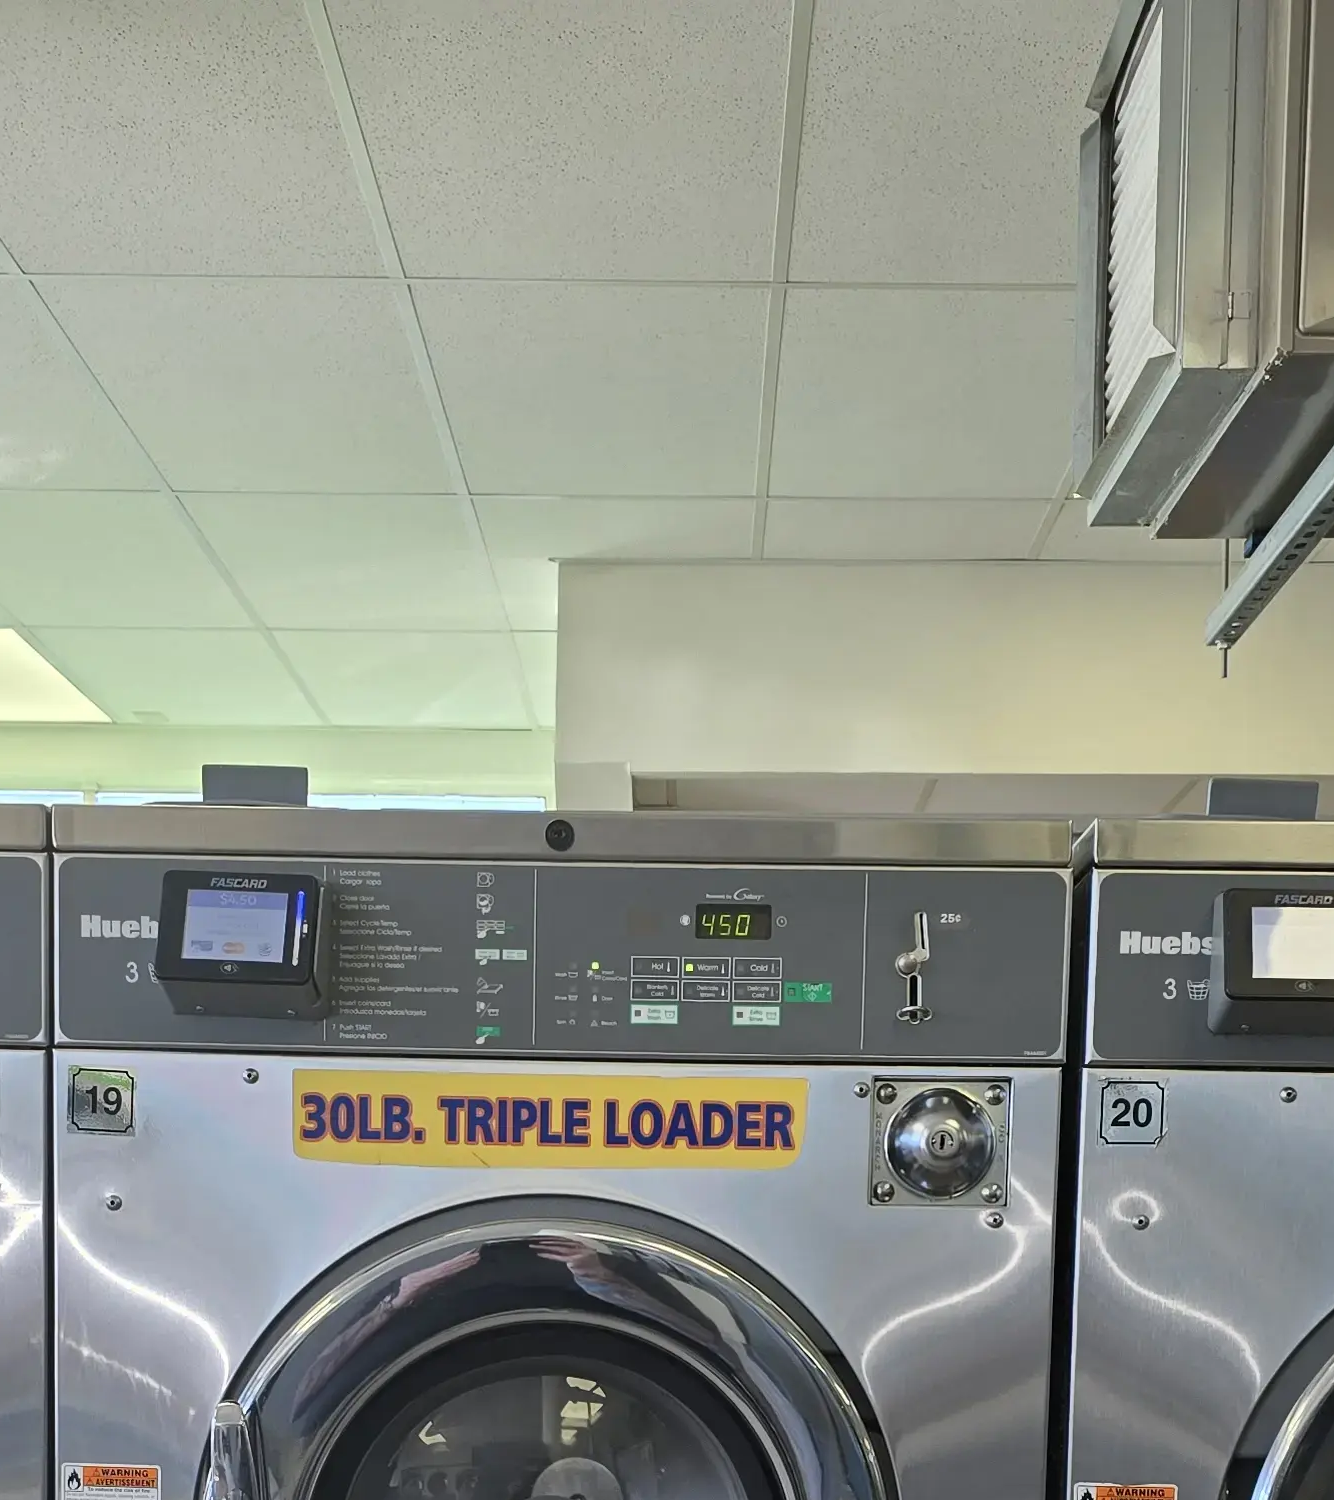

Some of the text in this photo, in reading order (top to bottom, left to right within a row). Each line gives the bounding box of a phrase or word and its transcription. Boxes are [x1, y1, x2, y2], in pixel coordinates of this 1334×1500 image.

[210, 878, 267, 888] FASCARD
[220, 893, 257, 906] $4.50
[1274, 894, 1333, 906] FASCARD
[702, 914, 751, 936] 450
[940, 913, 961, 924] 25¢
[125, 962, 139, 983] 3
[1163, 978, 1176, 999] 3
[86, 1086, 122, 1115] 19
[300, 1093, 795, 1151] 30LB. TRIPLE LOADER
[1111, 1098, 1153, 1127] 20
[1115, 1488, 1165, 1497] WARNING
